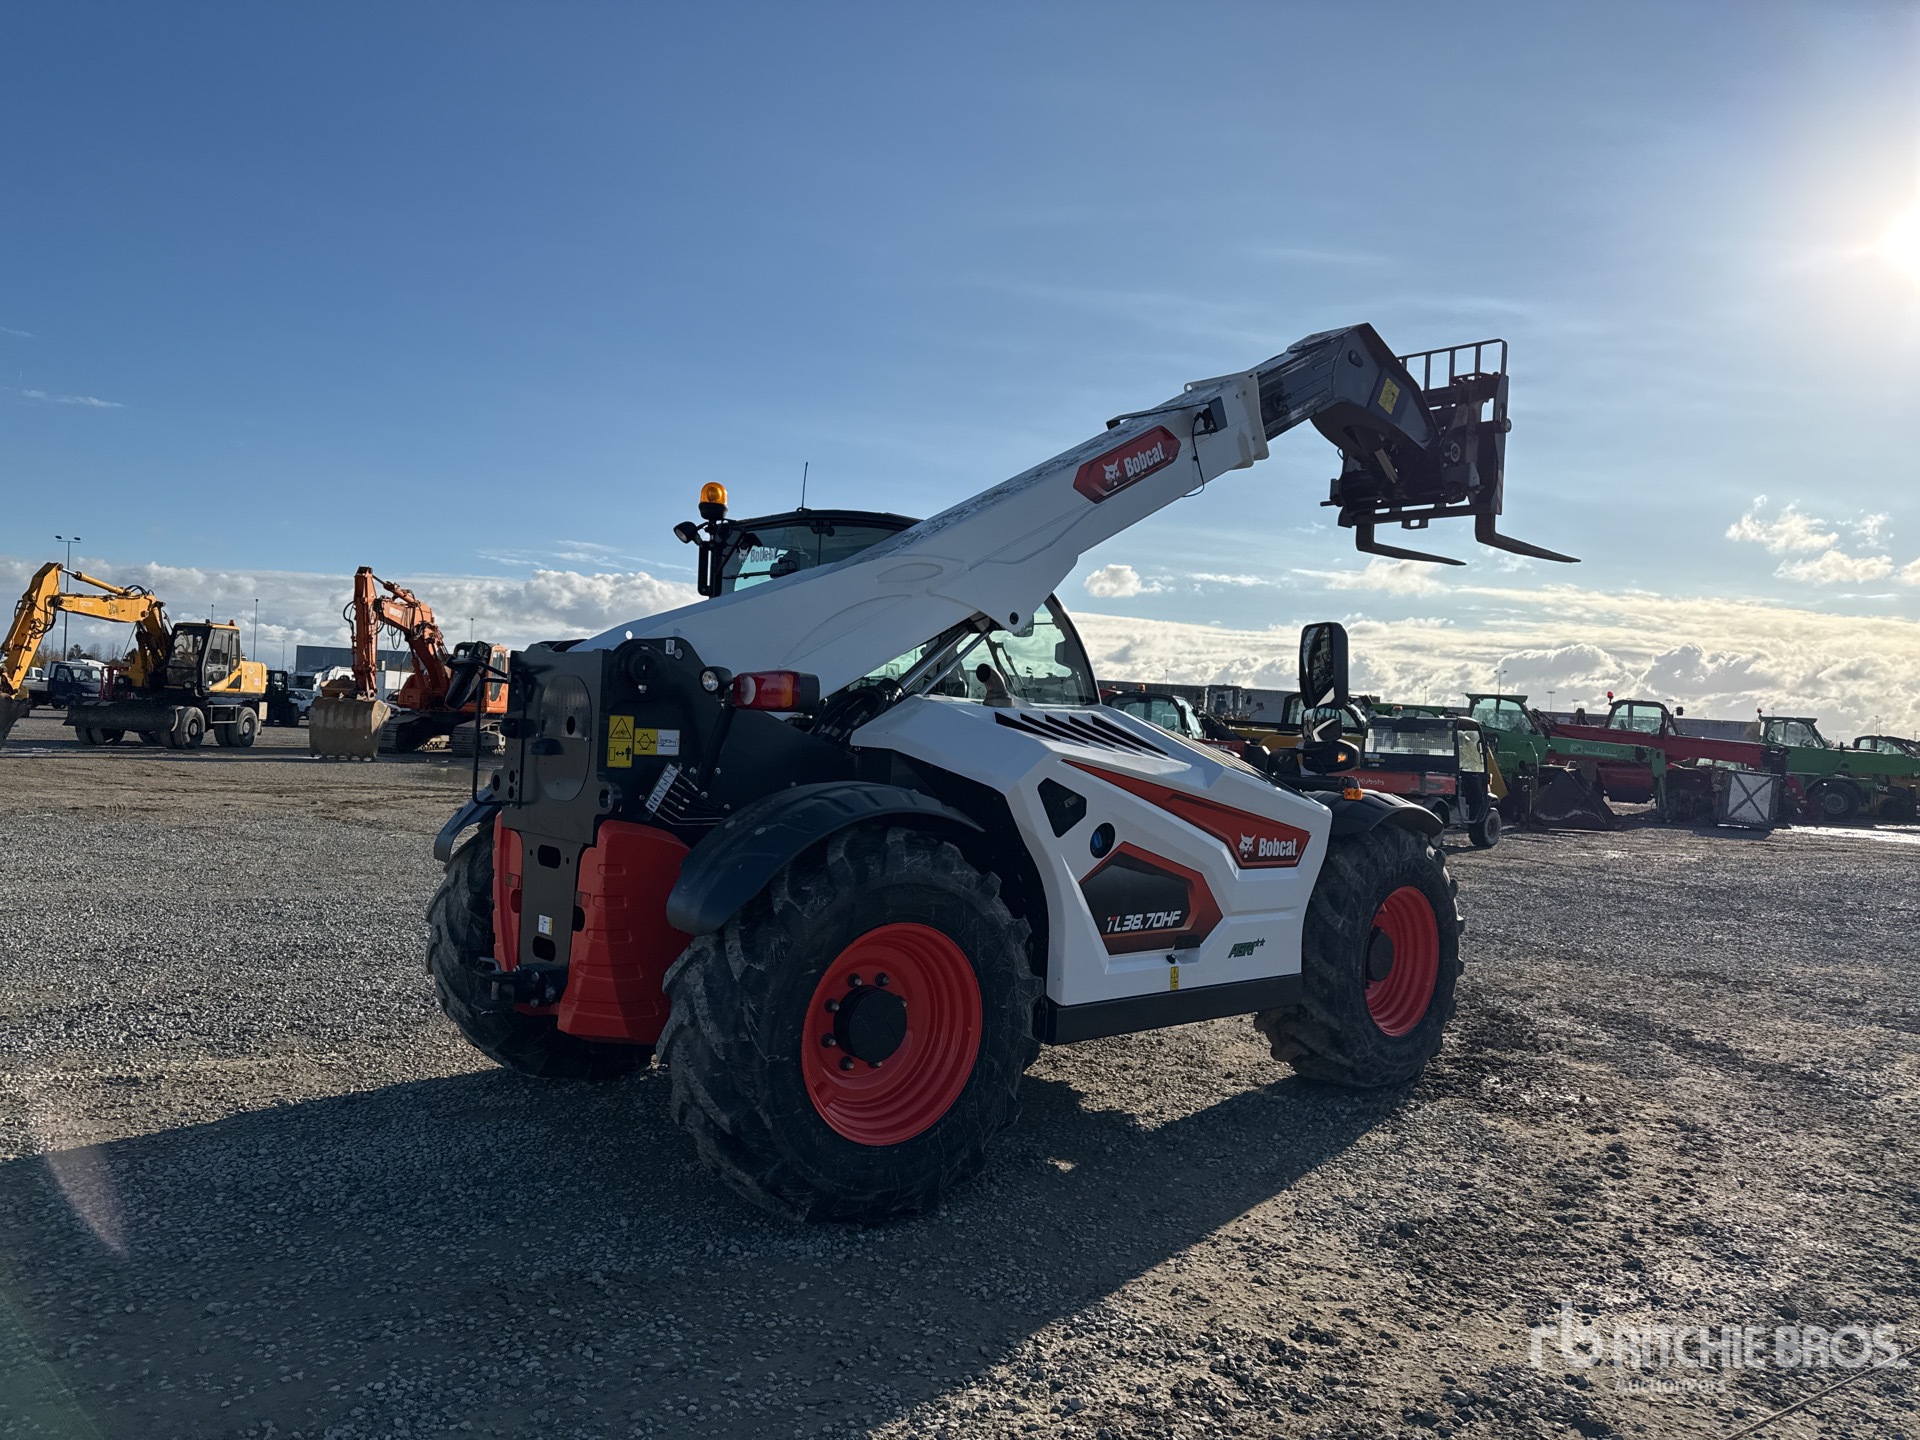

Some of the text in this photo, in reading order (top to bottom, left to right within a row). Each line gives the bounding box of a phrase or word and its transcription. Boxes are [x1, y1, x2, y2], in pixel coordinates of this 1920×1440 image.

[1124, 441, 1165, 478] Bobcat
[751, 547, 777, 563] Bobcat
[1359, 777, 1385, 786] Kubota
[1258, 837, 1297, 857] Bobcat
[1107, 910, 1182, 933] TL38.70HF
